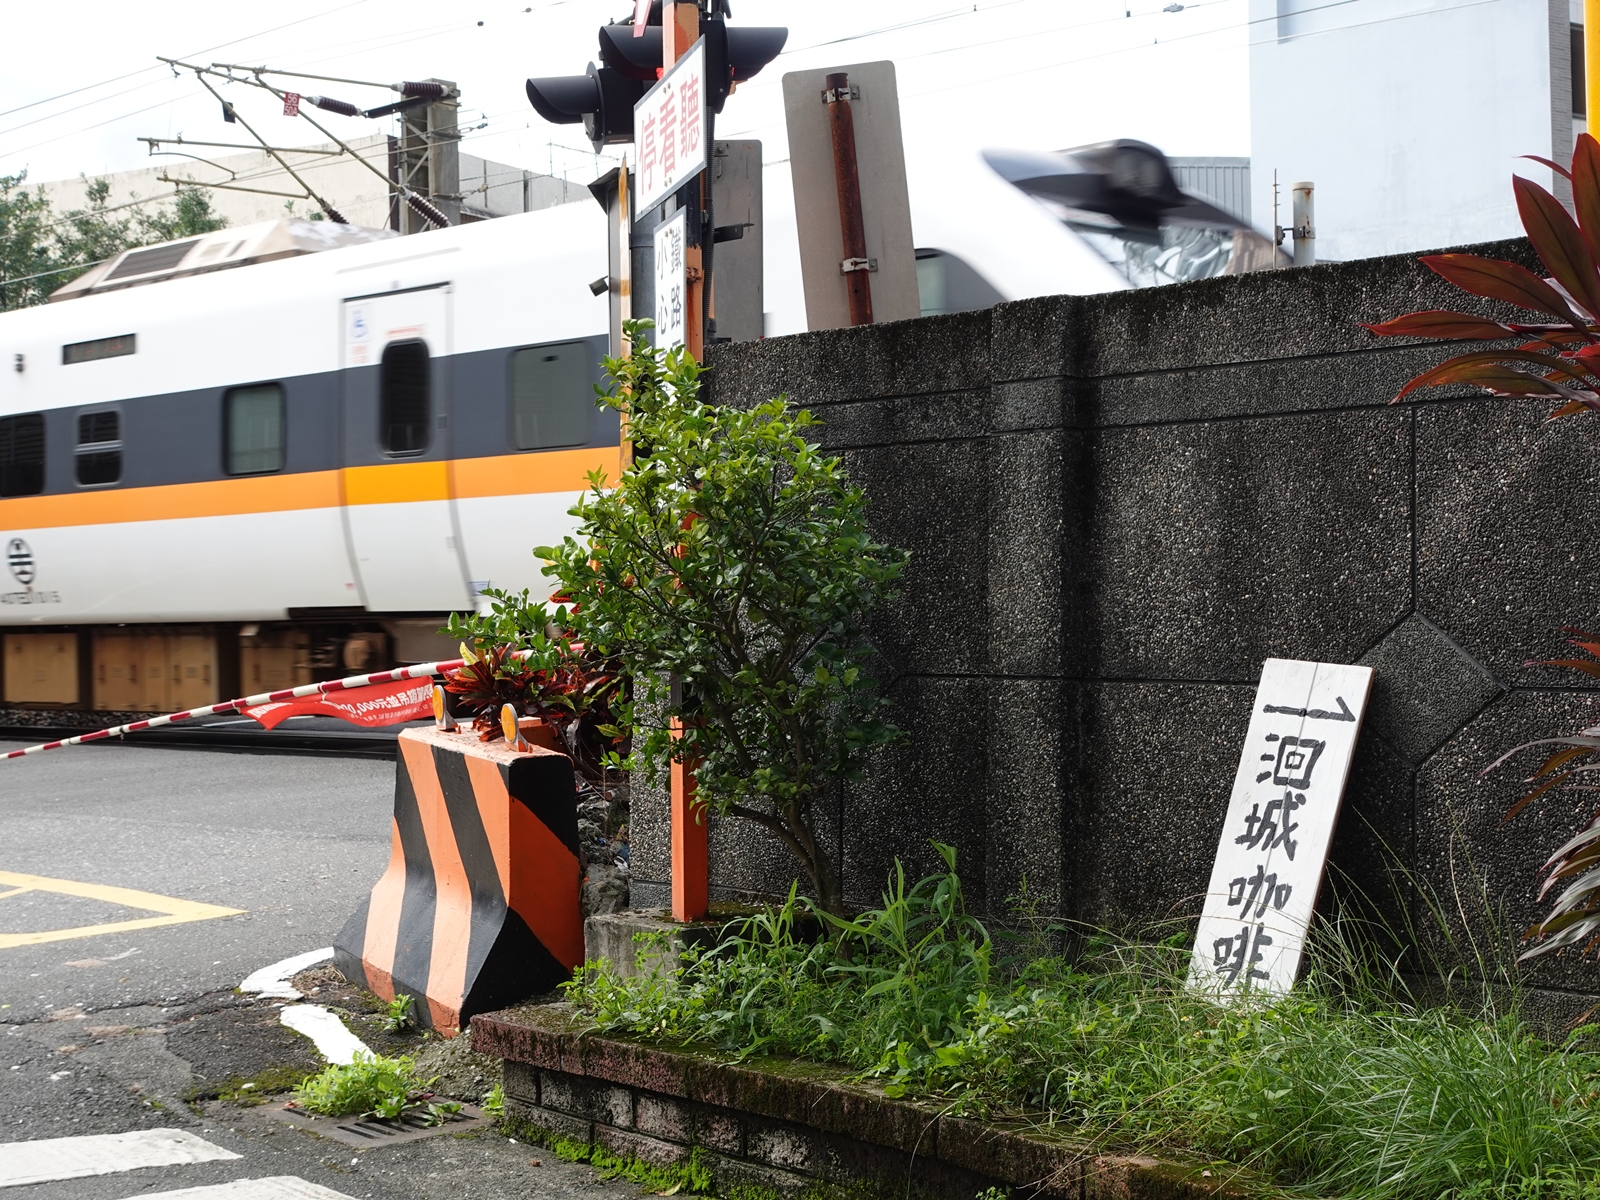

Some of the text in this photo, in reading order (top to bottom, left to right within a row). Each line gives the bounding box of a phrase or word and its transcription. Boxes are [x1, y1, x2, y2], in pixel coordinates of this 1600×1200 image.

[638, 72, 701, 197] 停看聽
[670, 225, 683, 348] 鐵路
